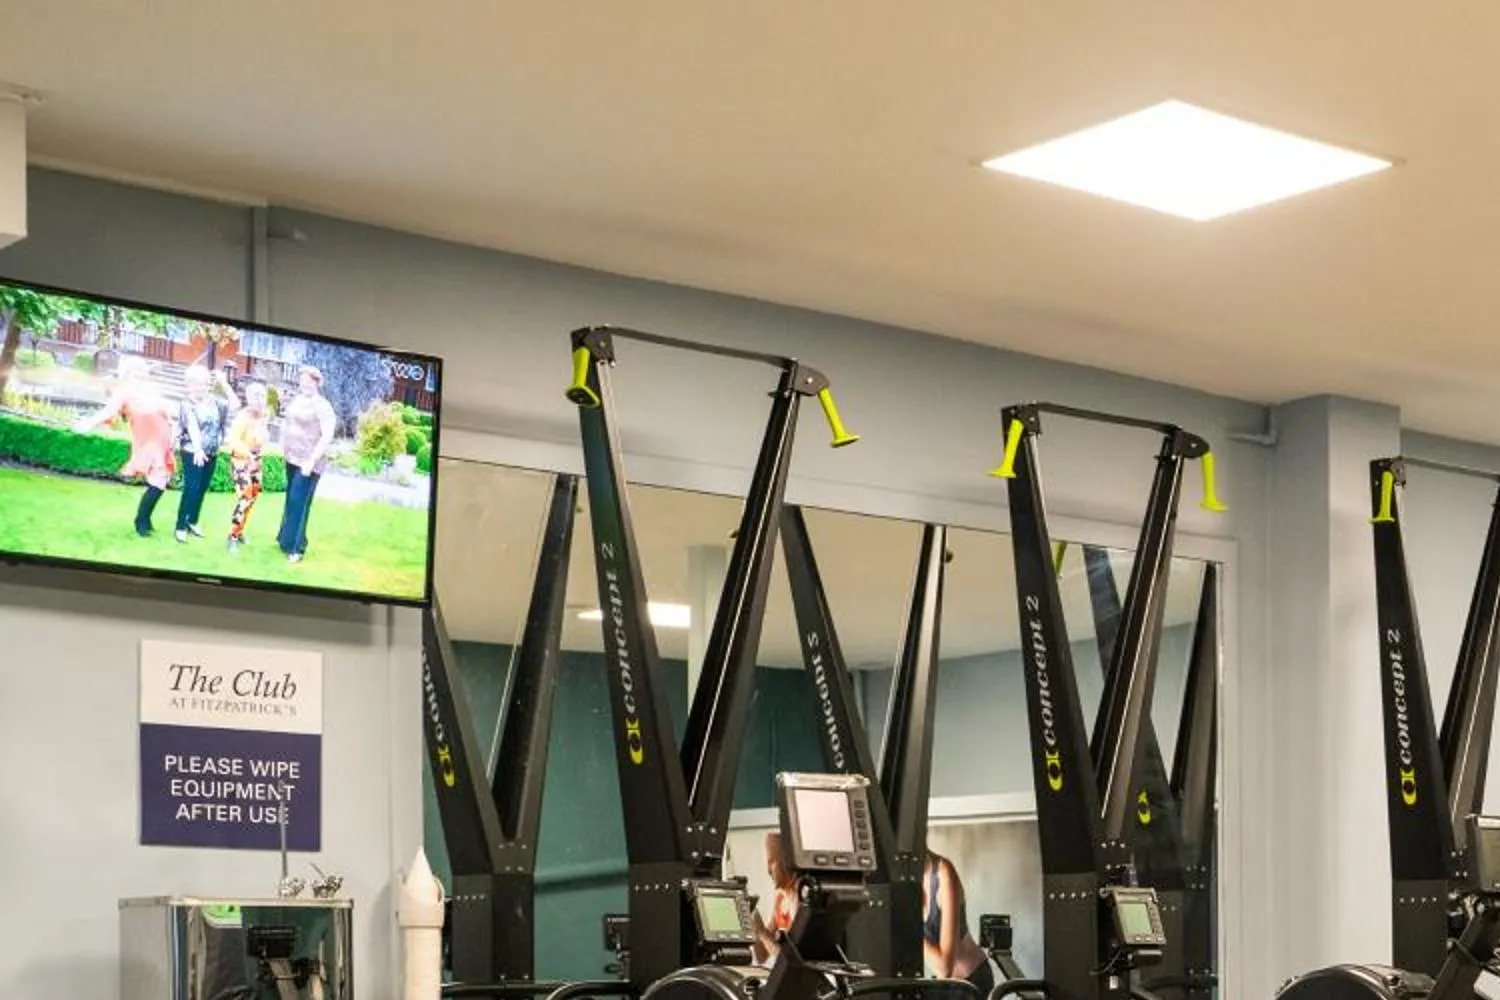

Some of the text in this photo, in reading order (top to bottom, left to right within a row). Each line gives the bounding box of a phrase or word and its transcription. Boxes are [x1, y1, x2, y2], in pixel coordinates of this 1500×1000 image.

[169, 663, 297, 700] The Club
[1025, 595, 1057, 745] concept 2
[1387, 629, 1412, 765] concept 2
[164, 755, 301, 779] PLEASE WIPE
[171, 779, 296, 801] EQUIPMENT
[175, 803, 242, 823] AFTER
